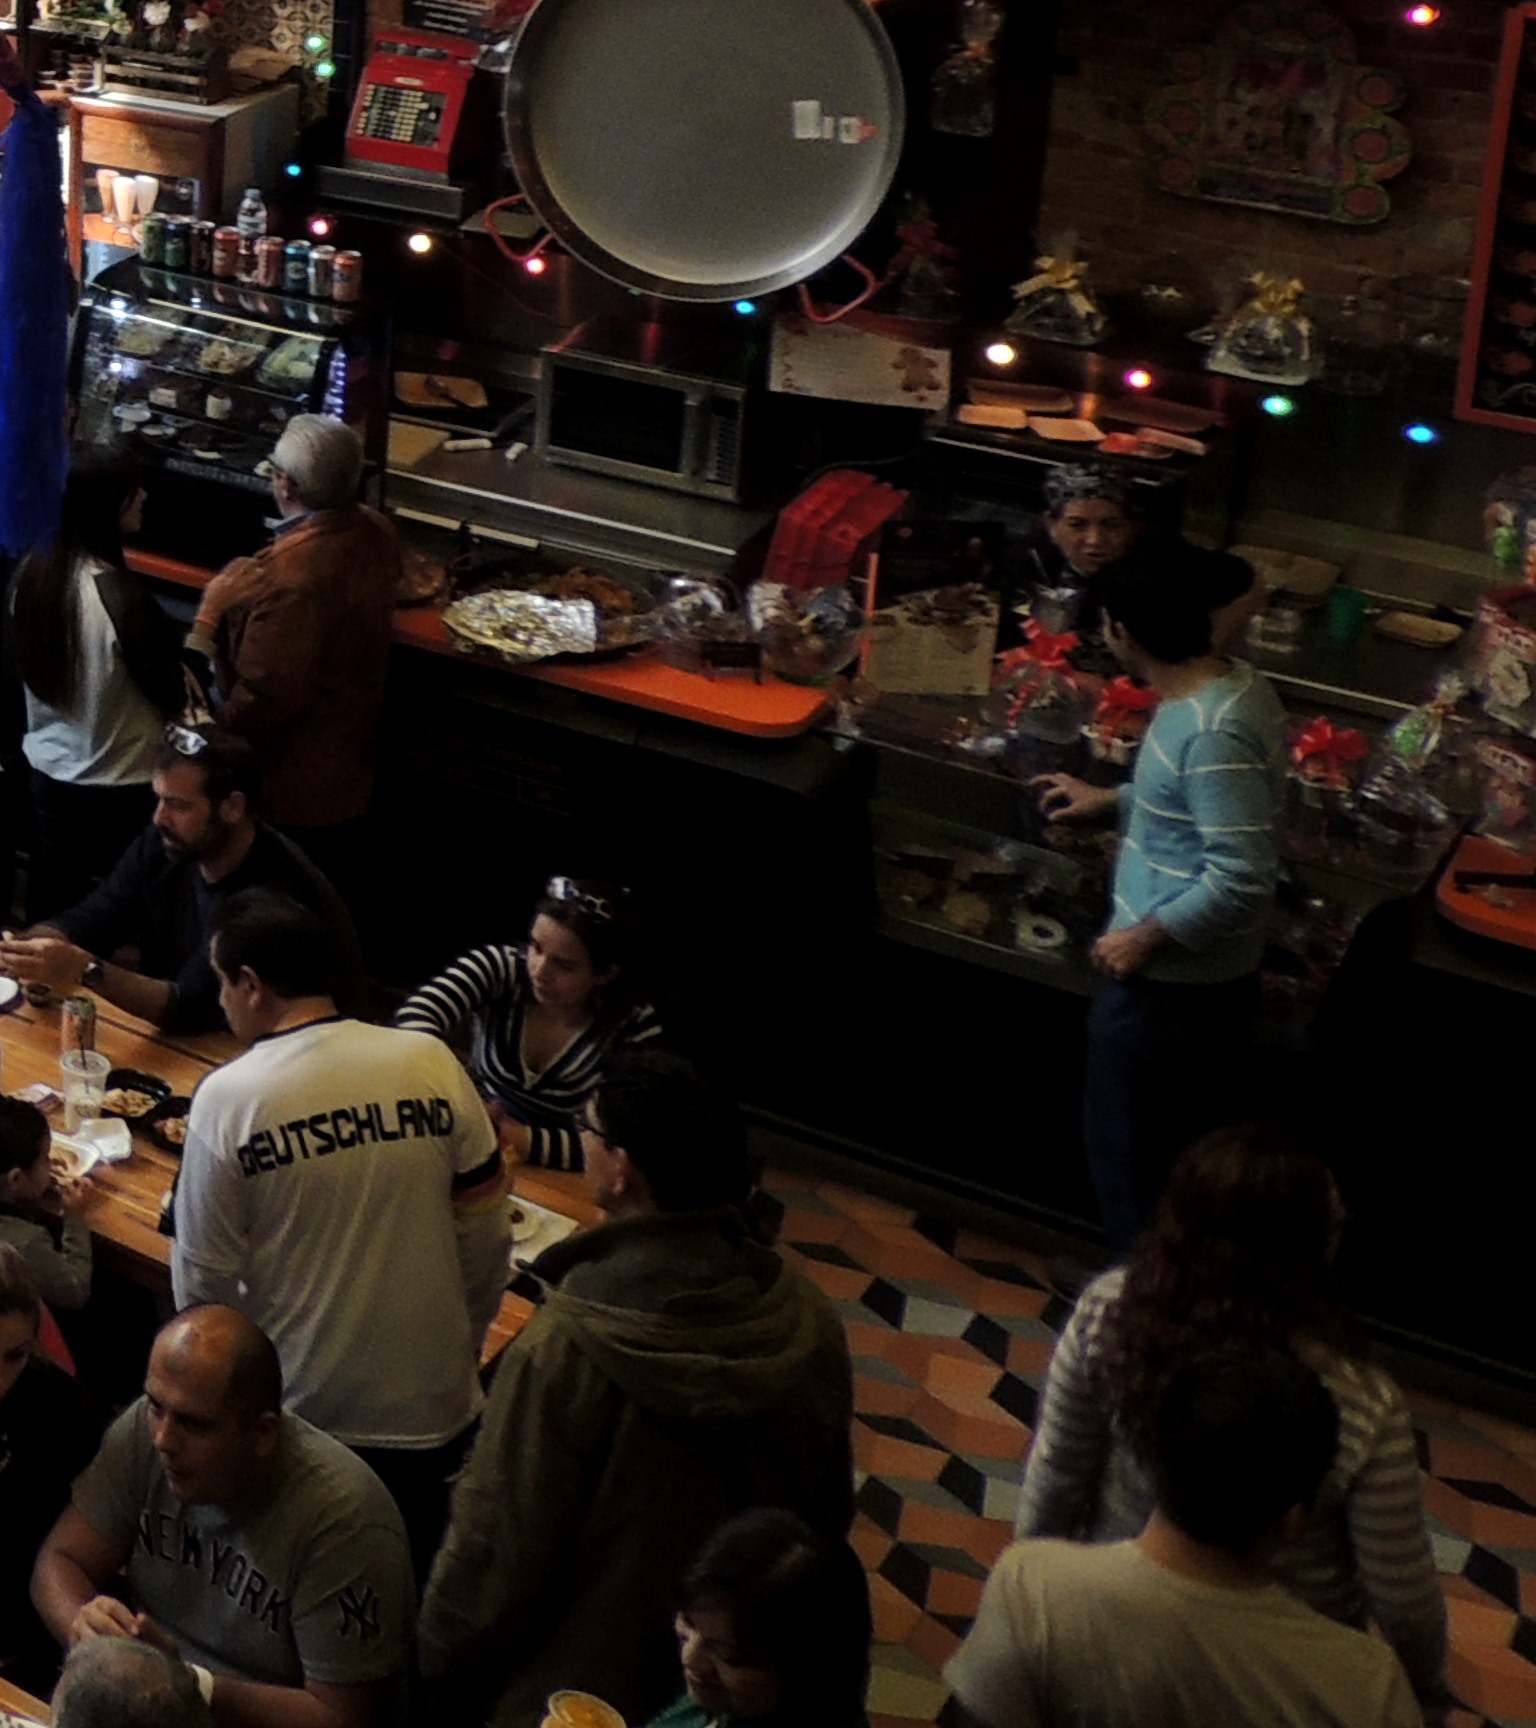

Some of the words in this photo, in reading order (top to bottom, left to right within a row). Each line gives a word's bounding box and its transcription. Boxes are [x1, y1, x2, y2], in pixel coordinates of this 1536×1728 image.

[237, 1097, 456, 1177] DEUTSCHLAND
[136, 1513, 201, 1569] NEW
[211, 1538, 291, 1633] YORK
